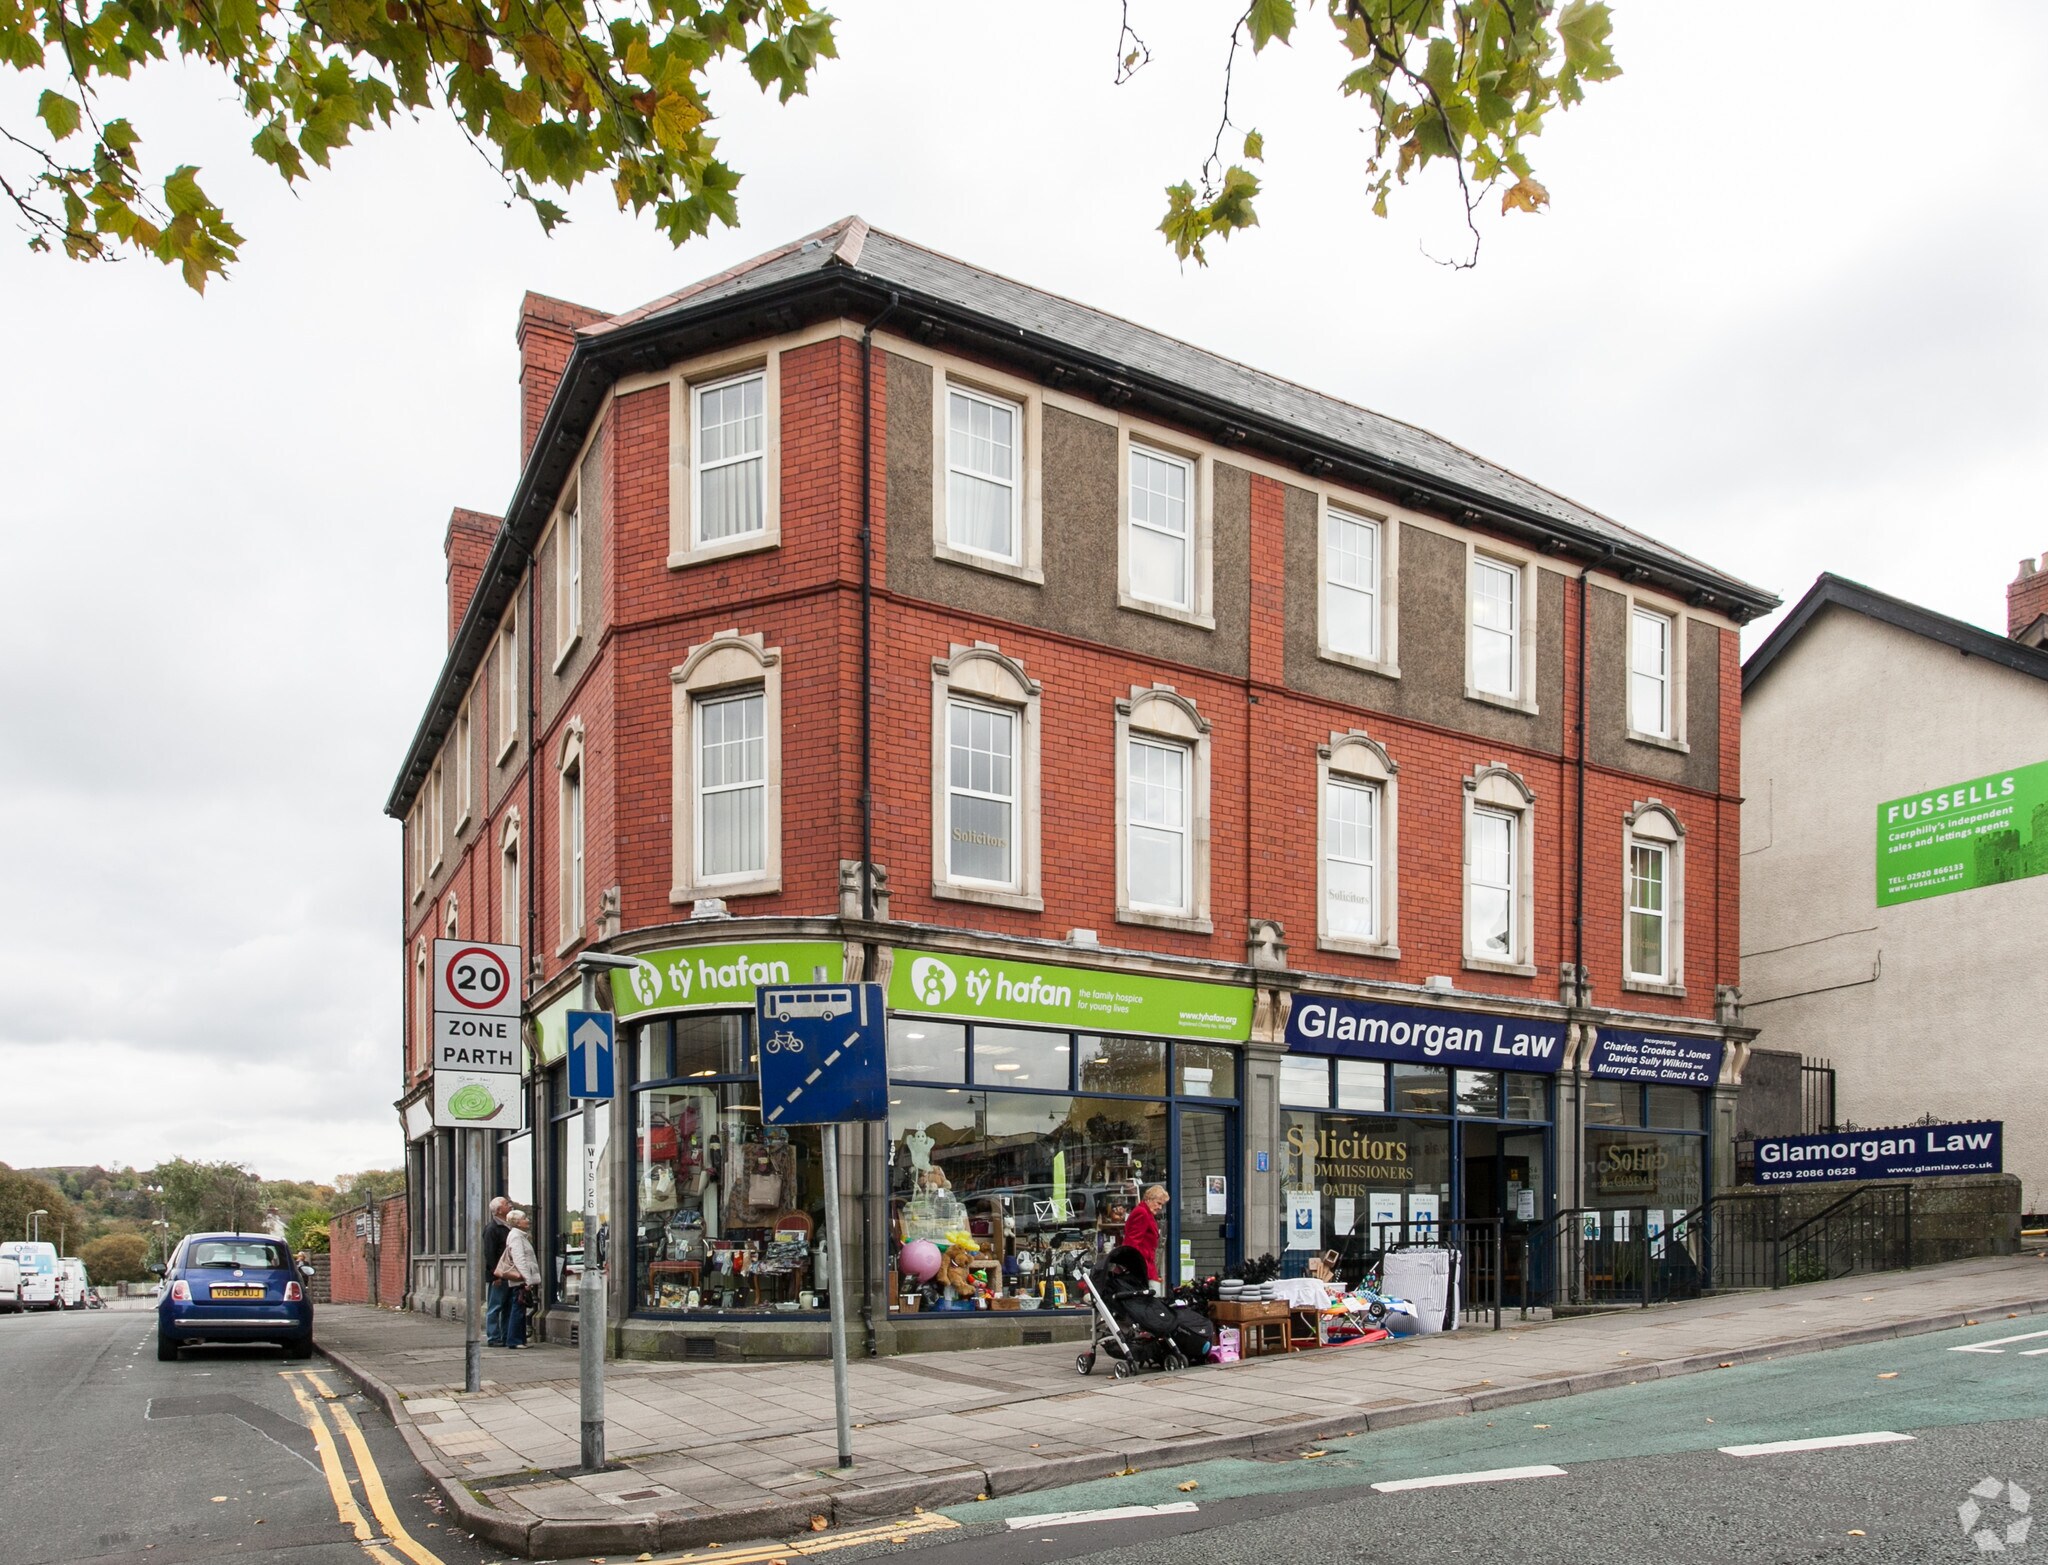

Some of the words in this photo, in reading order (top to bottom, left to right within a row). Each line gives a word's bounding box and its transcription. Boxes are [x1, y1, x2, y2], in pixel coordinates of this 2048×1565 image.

[1888, 777, 2015, 823] FUSSELLS
[1948, 806, 2013, 828] independent
[953, 827, 1008, 848] Solicitors
[1888, 842, 1912, 853] sales
[1915, 837, 1933, 847] and
[1936, 828, 1972, 843] lettings
[1975, 820, 2009, 834] agents
[1888, 877, 1905, 885] TEL:
[1907, 870, 1931, 881] 02920
[1934, 863, 1964, 875] 866133
[1888, 873, 1964, 893] WWW.FUSSELLS.NET
[457, 965, 500, 992] 20
[668, 958, 693, 999] tŷ
[698, 955, 790, 989] hafan
[965, 968, 992, 1006] tŷ
[996, 971, 1071, 1007] hafan
[1079, 989, 1091, 998] the
[1092, 990, 1114, 1002] family
[1116, 992, 1143, 1004] hospice
[1077, 1000, 1088, 1009] for
[1090, 1002, 1112, 1014] young
[1113, 1003, 1129, 1014] lives
[449, 1020, 507, 1039] ZONE
[1298, 1004, 1484, 1056] Glamorgan
[1493, 1024, 1556, 1058] Law
[443, 1047, 513, 1066] PARTH
[1603, 1041, 1639, 1054] Charles,
[1641, 1045, 1676, 1057] Crookes
[1678, 1049, 1684, 1057] &
[1686, 1050, 1711, 1060] Jones
[1608, 1053, 1637, 1064] Davies
[1639, 1056, 1661, 1068] Sully
[1662, 1058, 1692, 1069] Wilkins
[1597, 1064, 1630, 1076] Murray
[1630, 1067, 1658, 1078] Evans,
[1660, 1069, 1687, 1080] Clinch
[1689, 1073, 1695, 1081] &
[1697, 1073, 1709, 1082] Co
[1286, 1127, 1407, 1161] Solicitors
[1760, 1136, 1915, 1163] Glamorgan
[1927, 1132, 1993, 1152] Law
[1288, 1163, 1296, 1176] &
[1302, 1164, 1413, 1180] COMMISSIONERS
[1772, 1170, 1793, 1179] 029
[1796, 1169, 1824, 1178] 2086
[1828, 1167, 1856, 1176] 0628
[1887, 1161, 1993, 1174] www.glamlaw.co.uk
[587, 1188, 595, 1208] 26
[1288, 1182, 1314, 1196] FOR
[1322, 1183, 1366, 1197] OATHS
